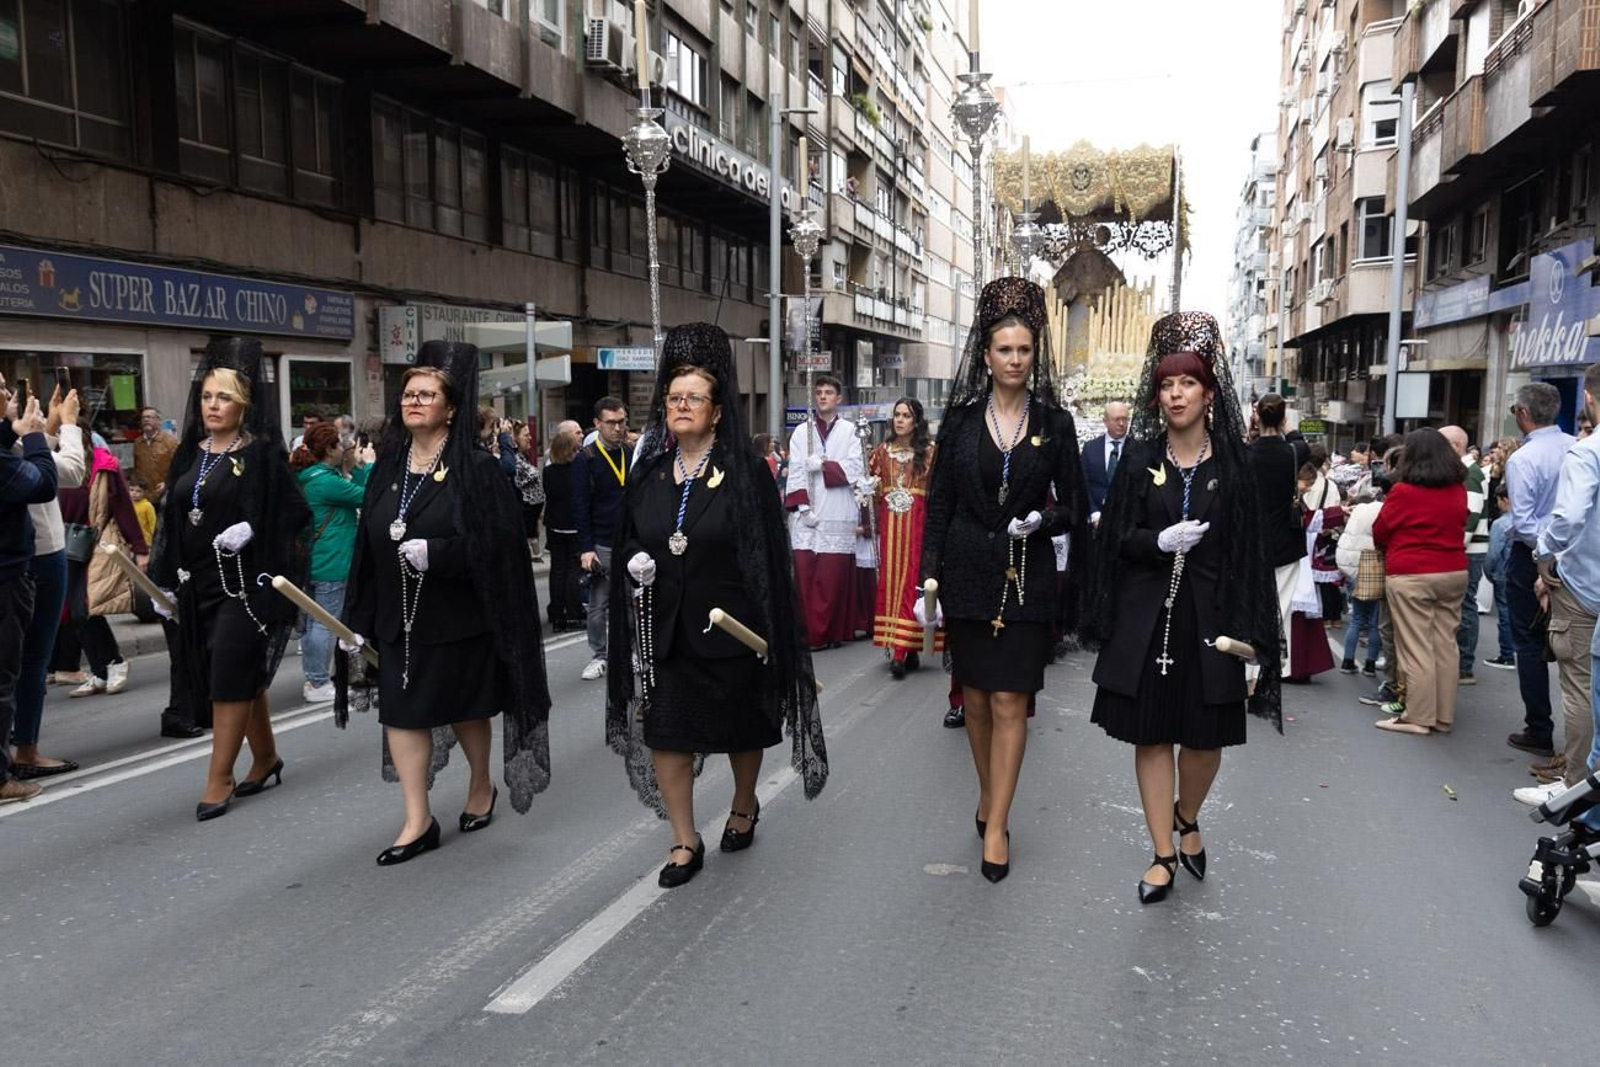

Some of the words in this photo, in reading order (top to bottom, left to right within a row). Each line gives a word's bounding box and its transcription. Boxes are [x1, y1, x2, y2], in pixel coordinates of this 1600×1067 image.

[672, 125, 741, 183] clinica
[89, 271, 156, 314] SUPER
[164, 280, 229, 321] BAZAR
[235, 289, 287, 326] CHINO
[424, 304, 490, 323] STAURANTE
[405, 308, 416, 363] CHINO
